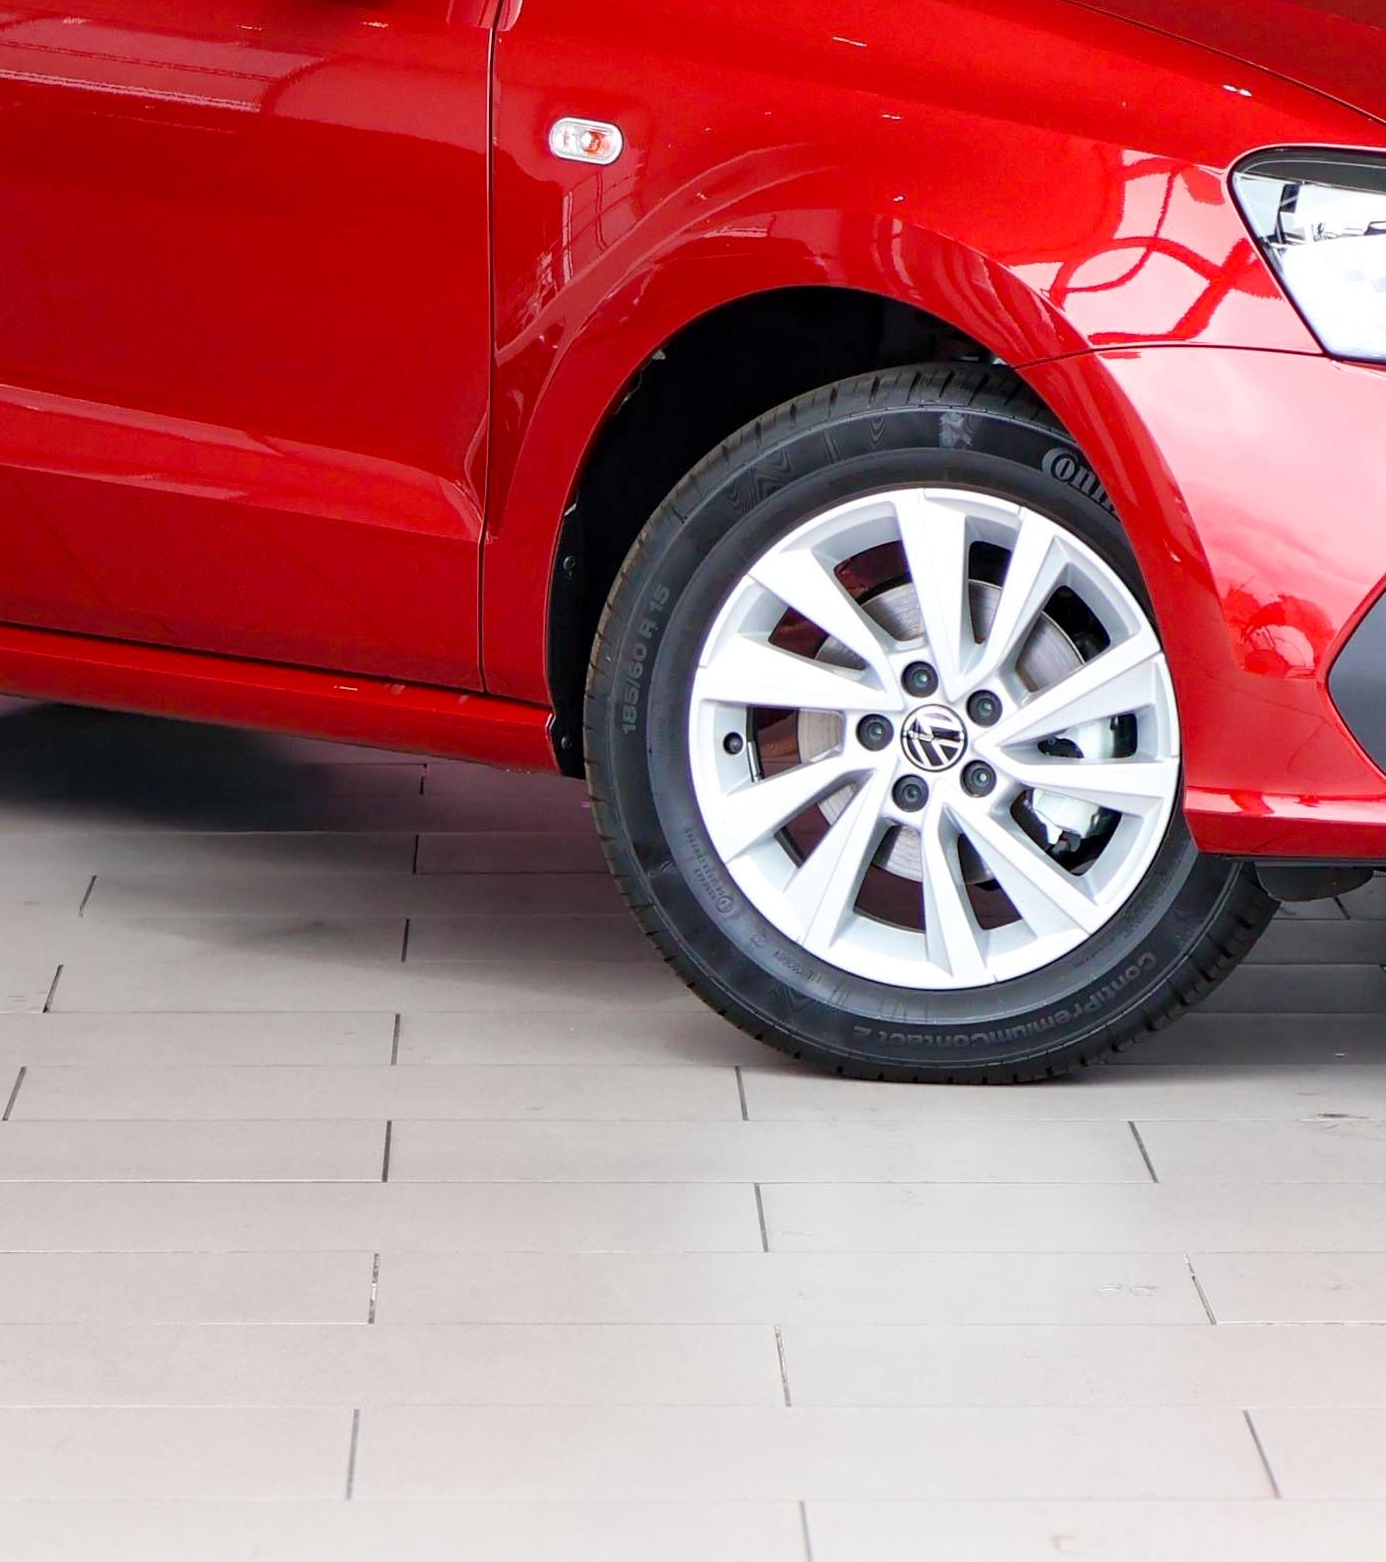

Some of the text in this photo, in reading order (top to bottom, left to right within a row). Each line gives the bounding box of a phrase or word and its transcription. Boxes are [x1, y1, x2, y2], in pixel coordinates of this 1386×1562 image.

[620, 582, 670, 736] 185/60 R 15
[876, 950, 1157, 1050] ContiPremiumContact
